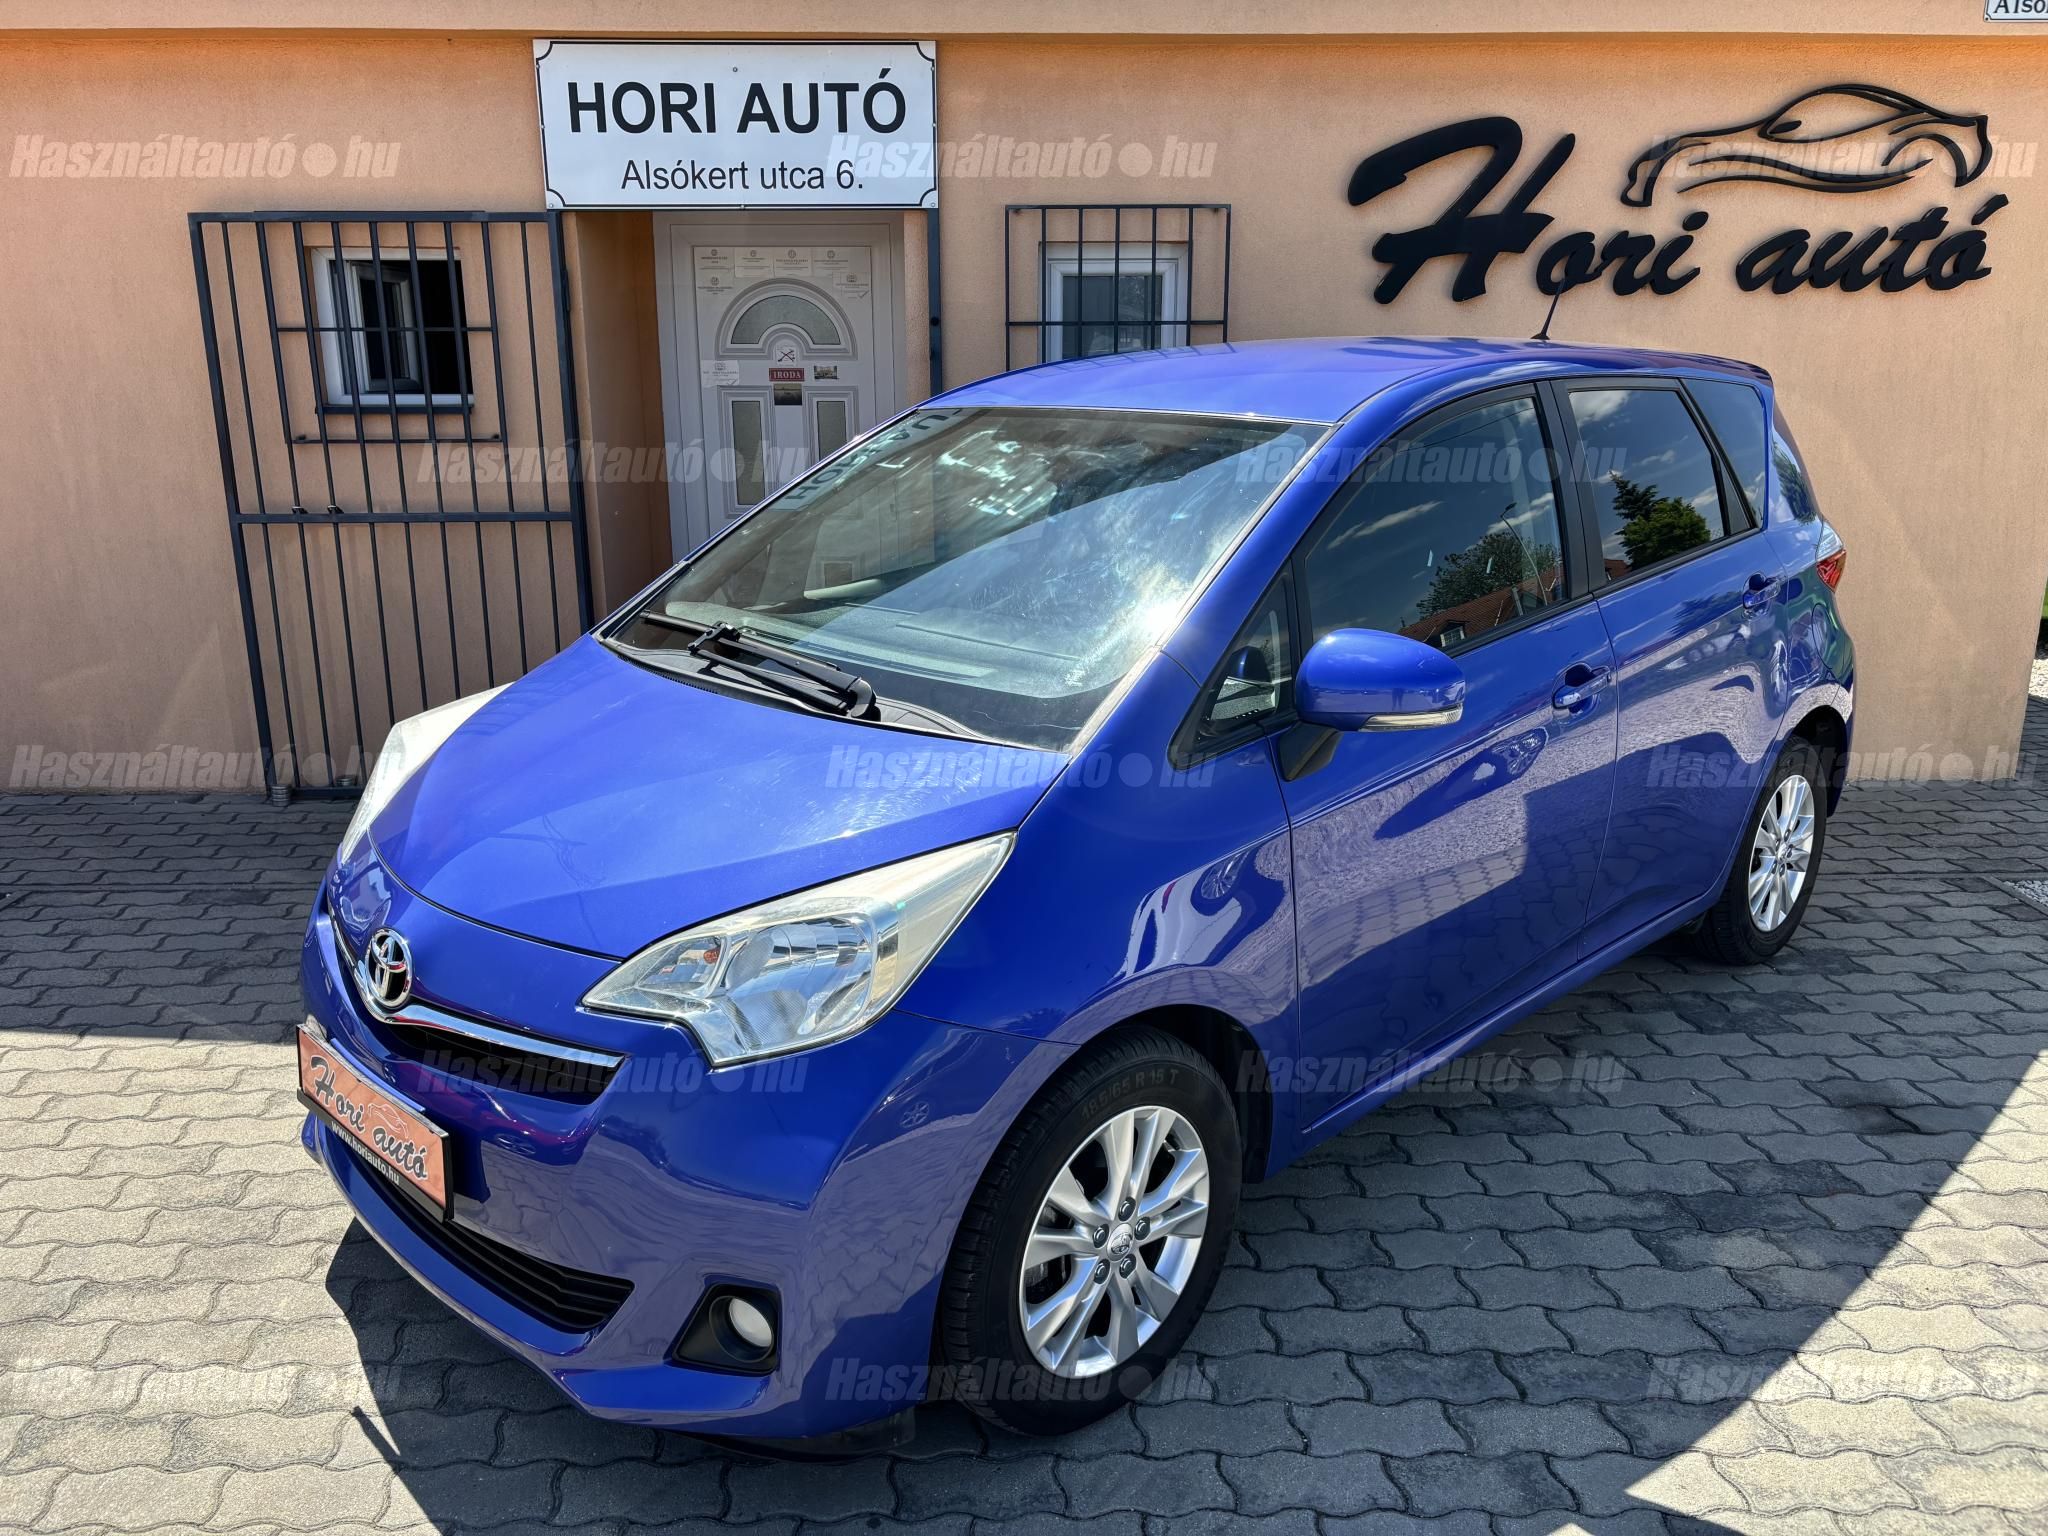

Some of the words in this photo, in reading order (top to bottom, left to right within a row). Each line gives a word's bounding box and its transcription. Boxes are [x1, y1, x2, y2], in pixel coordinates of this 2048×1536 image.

[567, 81, 717, 134] HORI
[736, 67, 907, 134] AUTÓ
[621, 160, 750, 191] Alsókert
[760, 162, 825, 191] utca
[836, 160, 864, 190] 6.
[1347, 115, 1709, 304] Hori
[1735, 193, 2010, 295] autó
[773, 371, 801, 379] IRODA
[311, 1055, 366, 1133] Hori
[373, 1127, 428, 1180] autó
[331, 1120, 400, 1185] www.horiauto.hu
